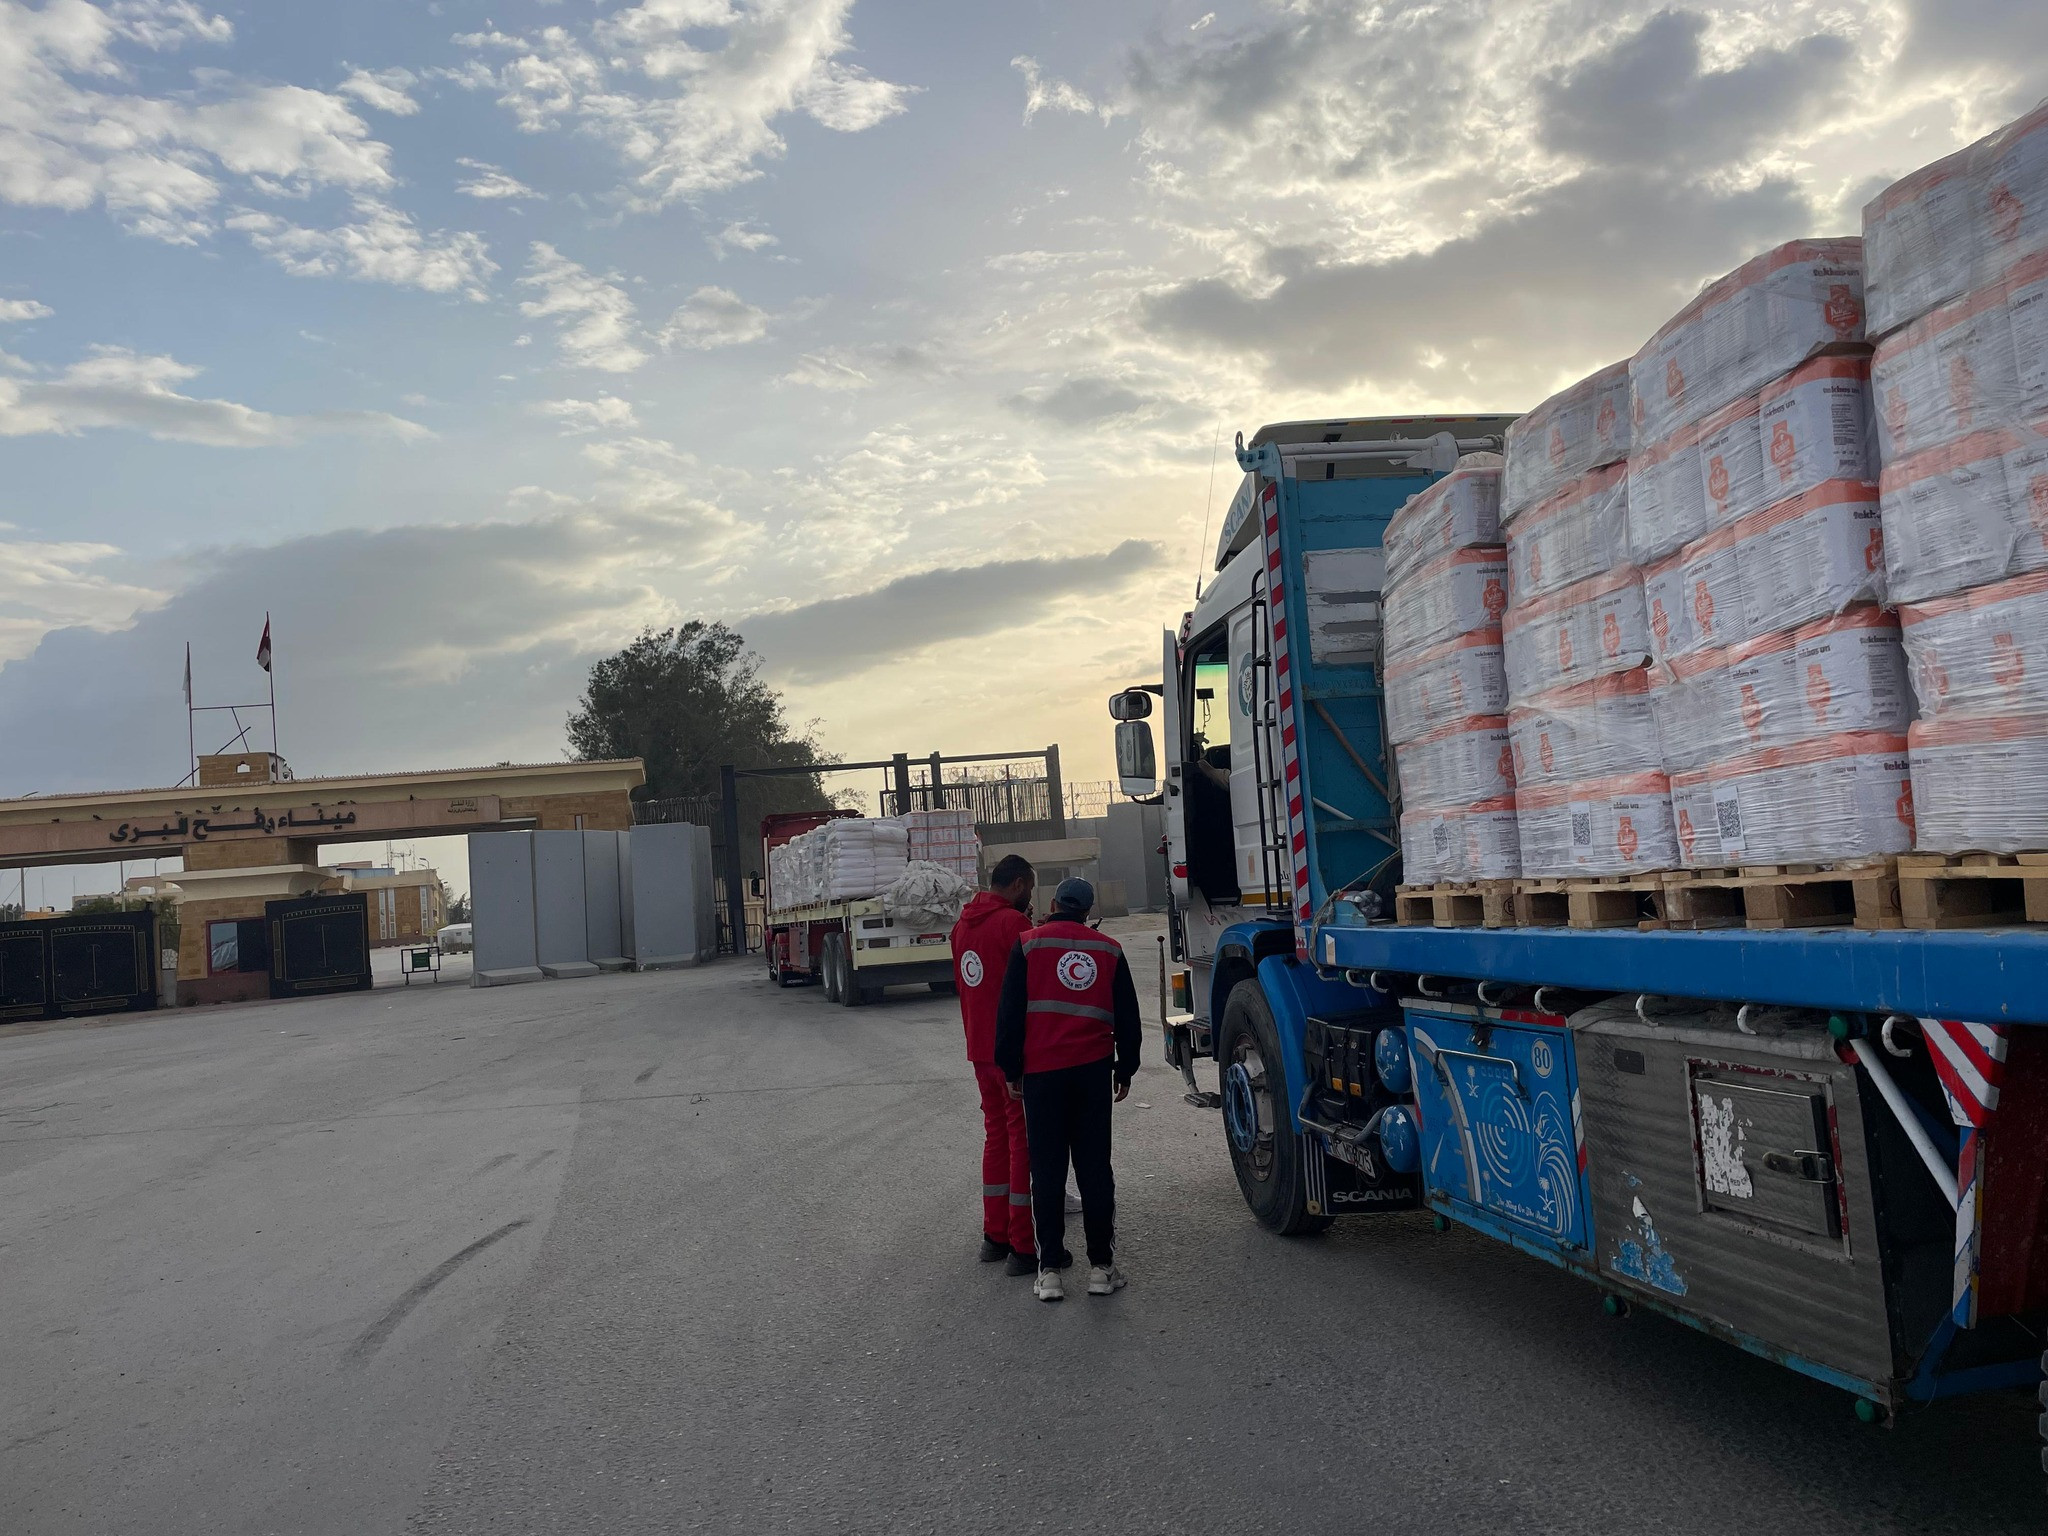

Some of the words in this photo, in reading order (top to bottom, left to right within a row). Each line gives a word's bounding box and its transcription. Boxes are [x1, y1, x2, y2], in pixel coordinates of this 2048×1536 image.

[192, 808, 276, 840] رفح
[277, 807, 356, 831] ميناء
[1534, 1046, 1551, 1069] 80
[1332, 1187, 1414, 1203] SCANIA
